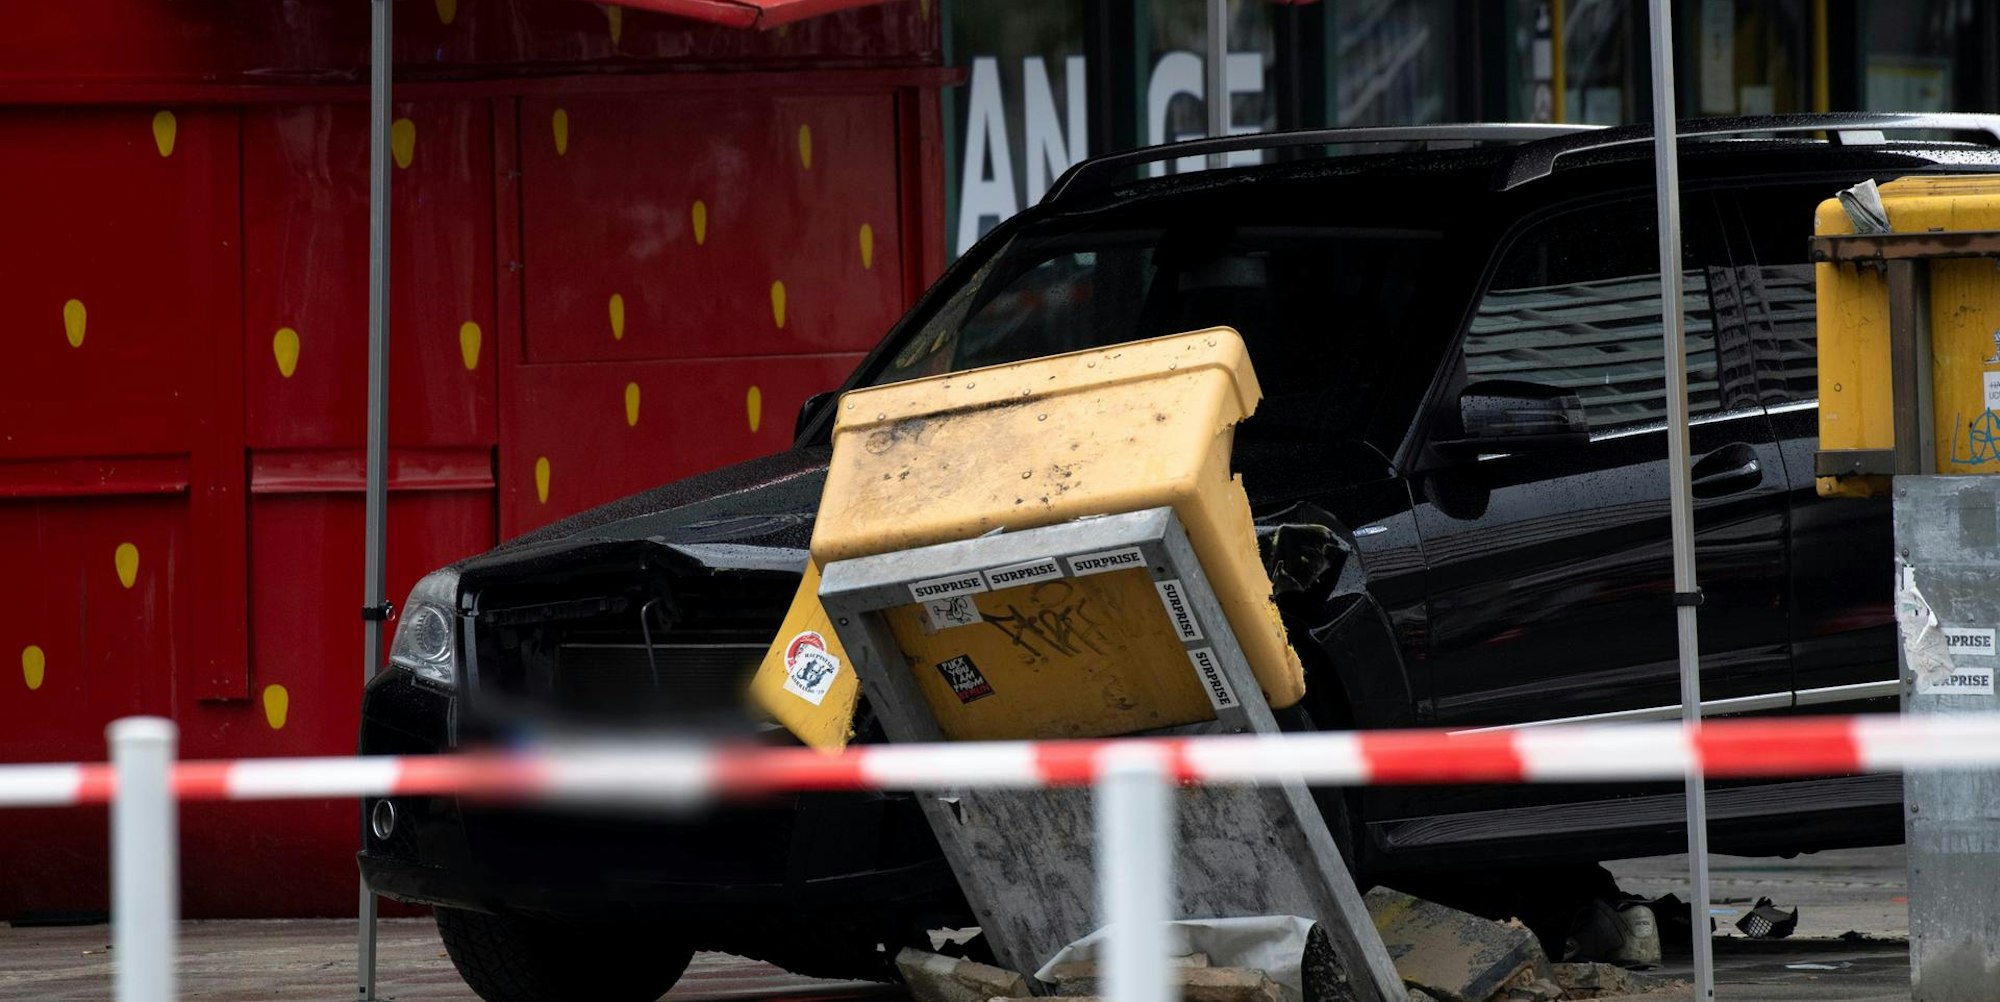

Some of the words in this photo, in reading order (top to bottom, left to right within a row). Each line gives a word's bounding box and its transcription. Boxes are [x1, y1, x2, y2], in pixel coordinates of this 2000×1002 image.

[1073, 552, 1140, 571] SURPRISE
[991, 563, 1057, 584] SURPRISE
[915, 577, 981, 597] SURPRISE
[1163, 583, 1195, 638] SURPRISE
[1945, 635, 1991, 648] RPRISE
[1195, 651, 1231, 706] SURPRISE
